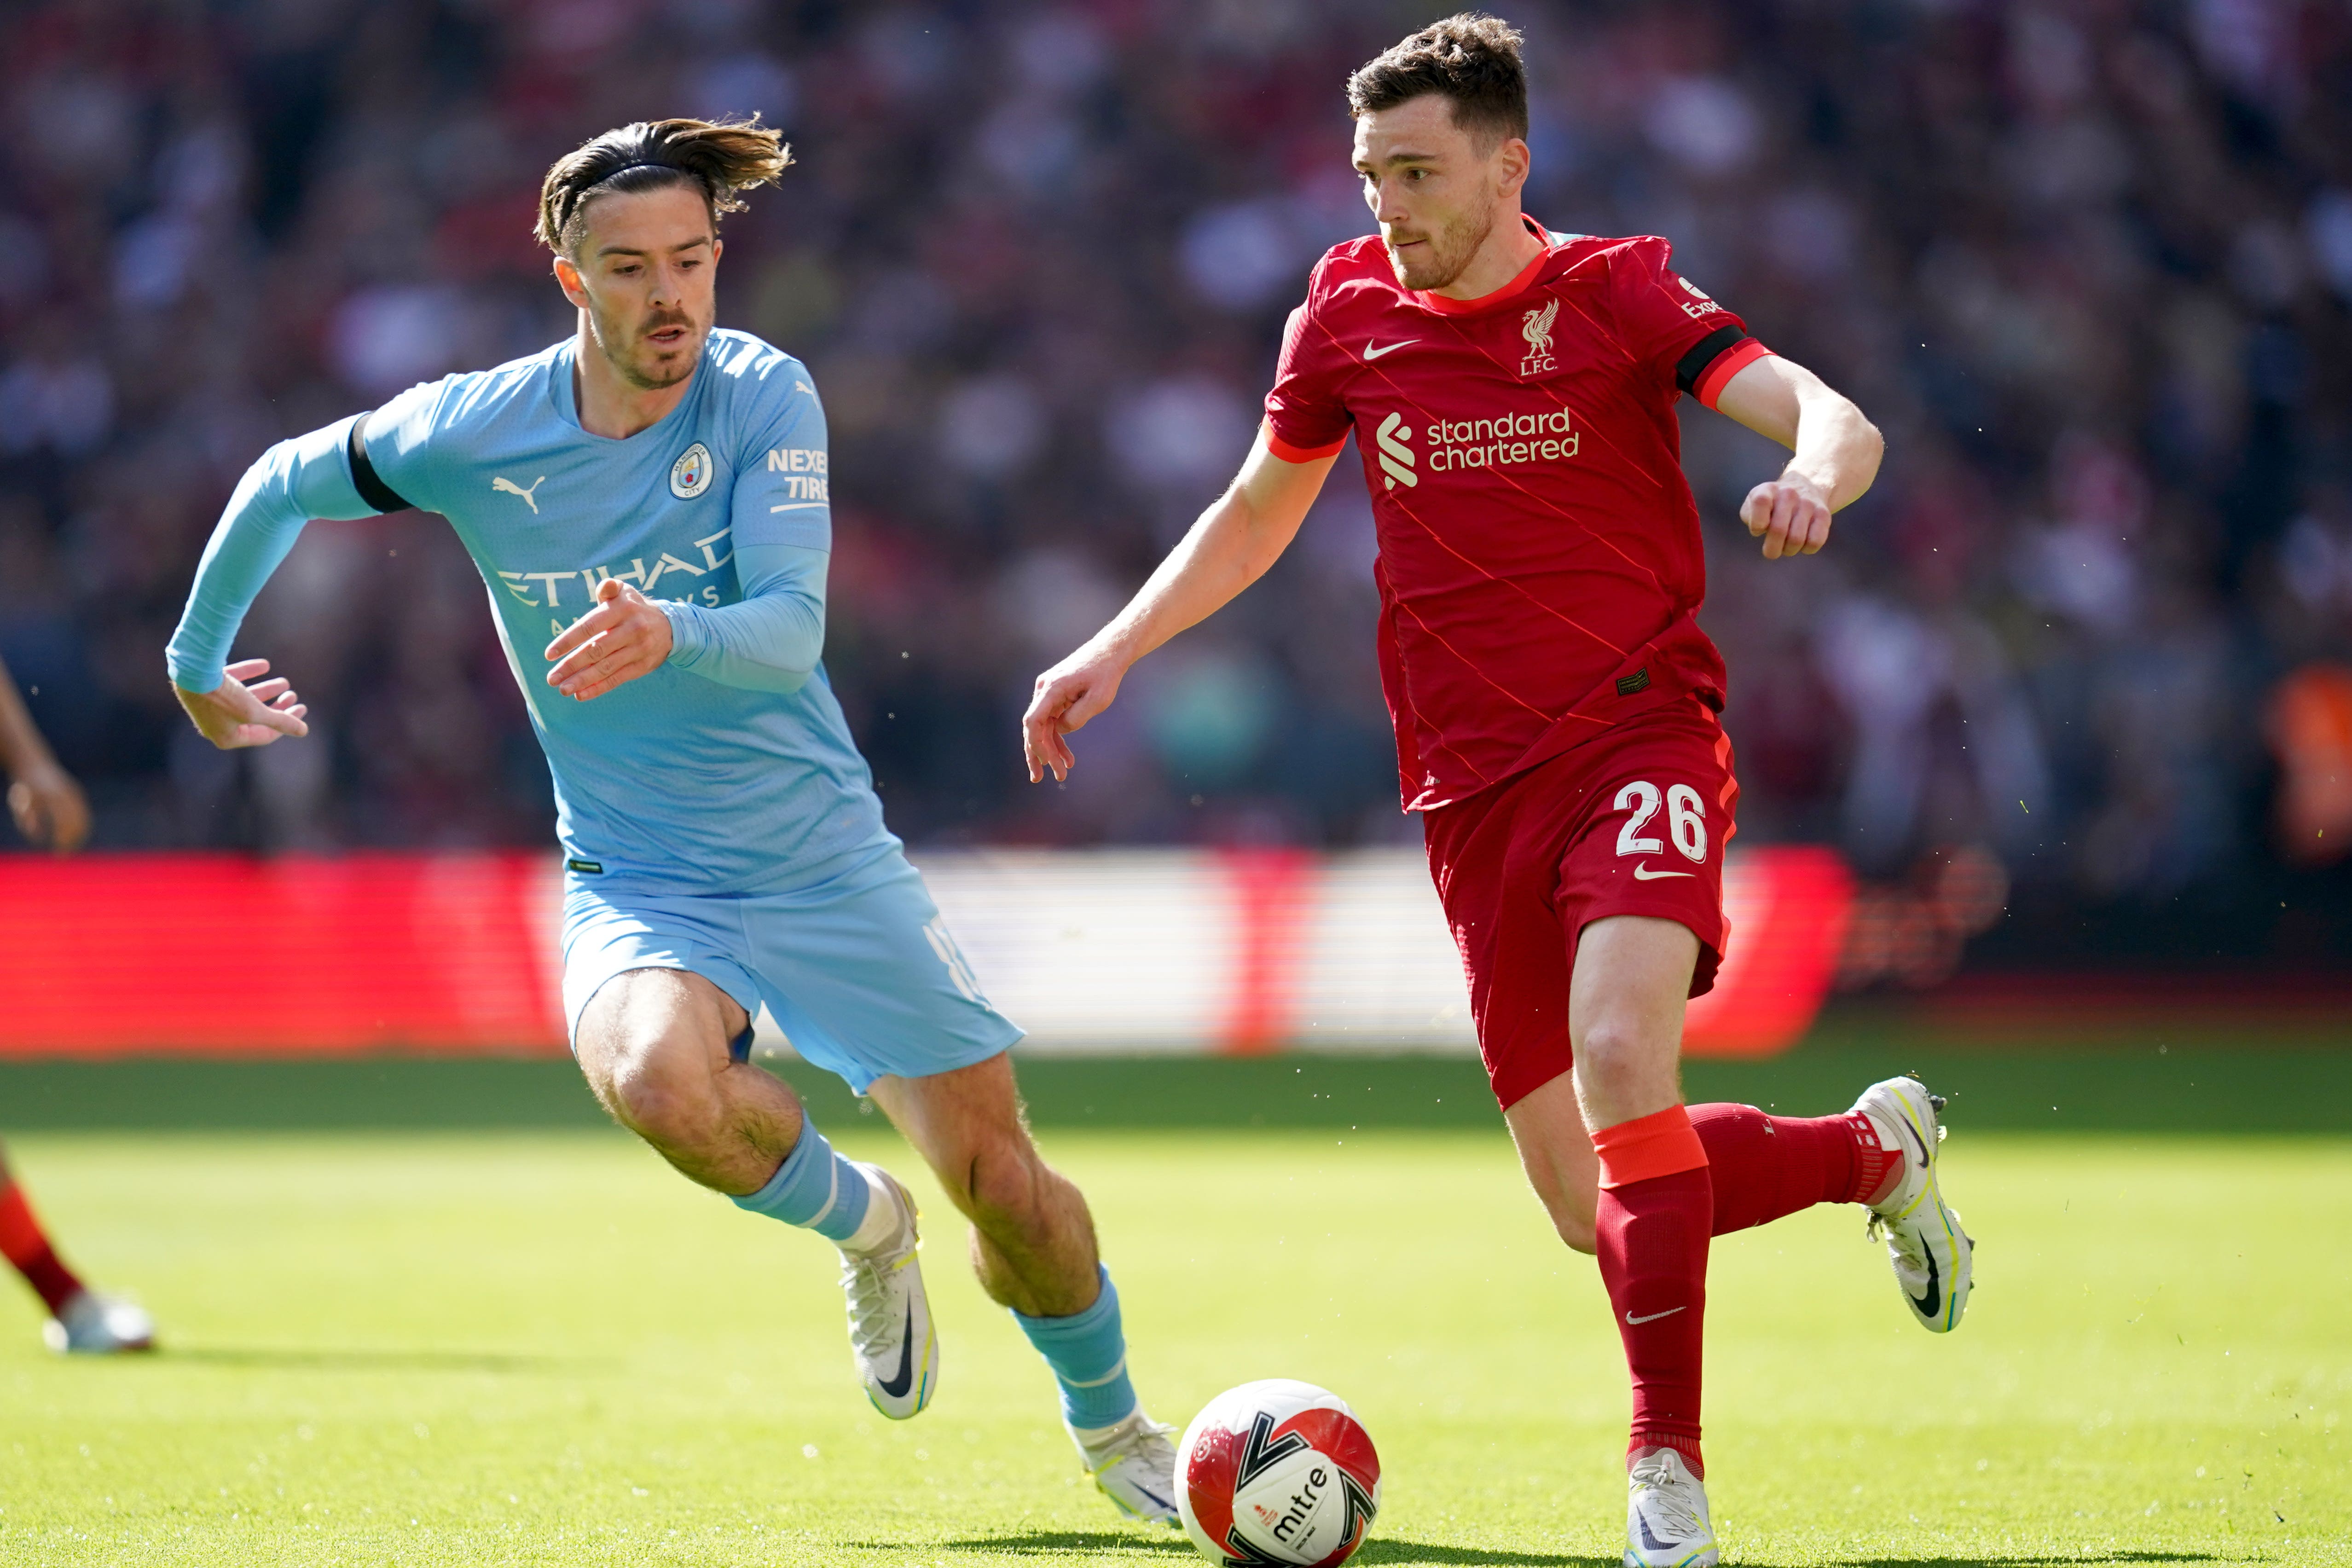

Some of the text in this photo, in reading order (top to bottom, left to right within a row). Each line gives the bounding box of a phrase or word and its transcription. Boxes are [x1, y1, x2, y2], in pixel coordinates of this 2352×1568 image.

[1520, 358, 1558, 376] L.F.C.
[1427, 406, 1570, 445] standard
[1429, 432, 1579, 471] chartered
[684, 486, 700, 496] CITY
[784, 476, 829, 501] TIRE
[497, 527, 733, 607] ETIHAD
[1613, 780, 1708, 864] 26
[1274, 1468, 1327, 1543] mitre
